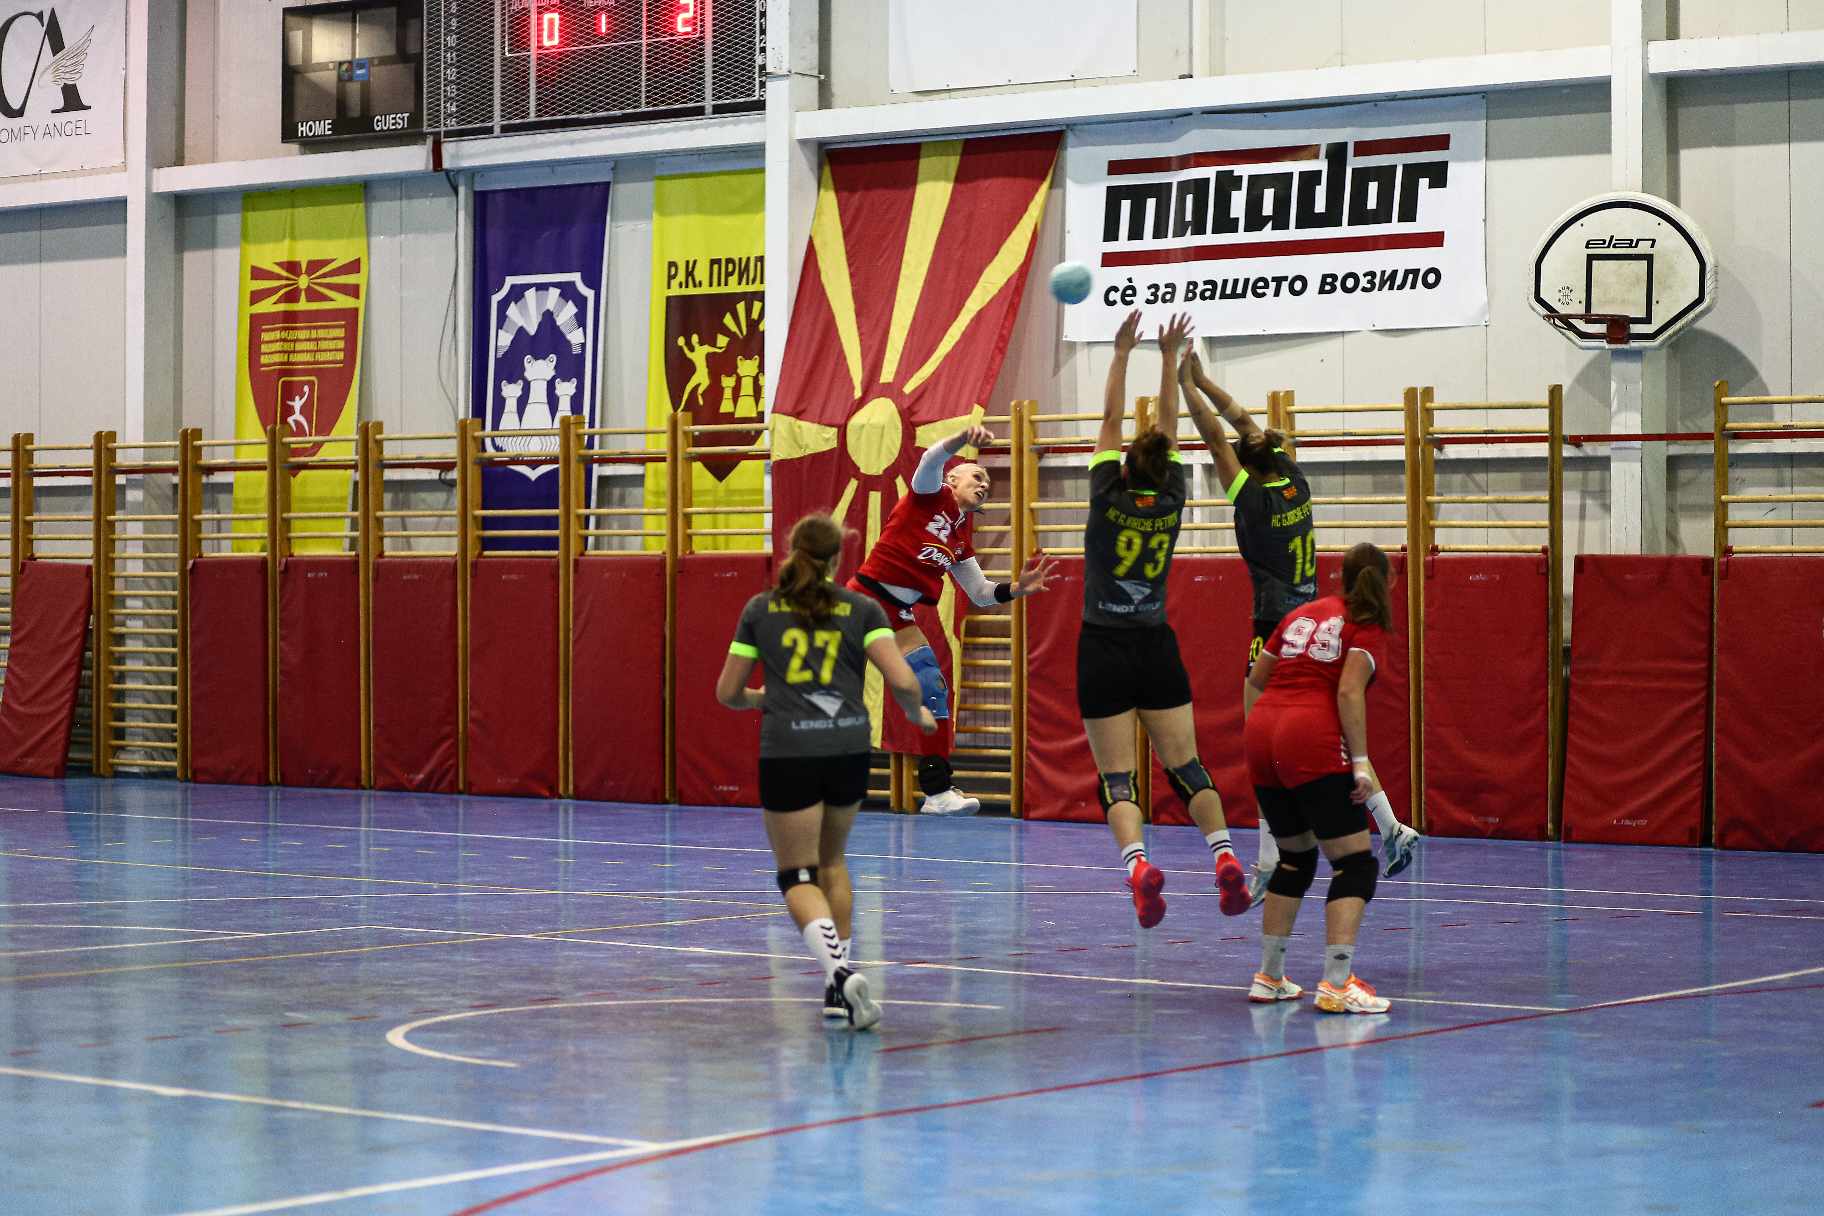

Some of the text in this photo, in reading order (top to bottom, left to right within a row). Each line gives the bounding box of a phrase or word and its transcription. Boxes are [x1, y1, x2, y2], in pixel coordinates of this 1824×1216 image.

[543, 12, 560, 46] 0
[601, 13, 607, 33] 1
[677, 0, 695, 32] 2
[446, 34, 457, 47] 10
[446, 68, 457, 80] 12
[446, 85, 457, 97] 13
[446, 101, 457, 114] 14
[0, 120, 92, 144] OMFY ANGEL
[298, 113, 410, 137] HOME GUEST
[1102, 141, 1449, 243] matador
[1585, 235, 1657, 249] elan
[666, 255, 765, 289] Р.К. ПРИЛ
[1145, 281, 1176, 305] за
[1183, 273, 1309, 303] вашето
[1318, 266, 1442, 295] возило
[1113, 528, 1171, 579] 93
[1288, 528, 1316, 585] 10
[1280, 616, 1345, 662] 99
[781, 627, 842, 685] 27
